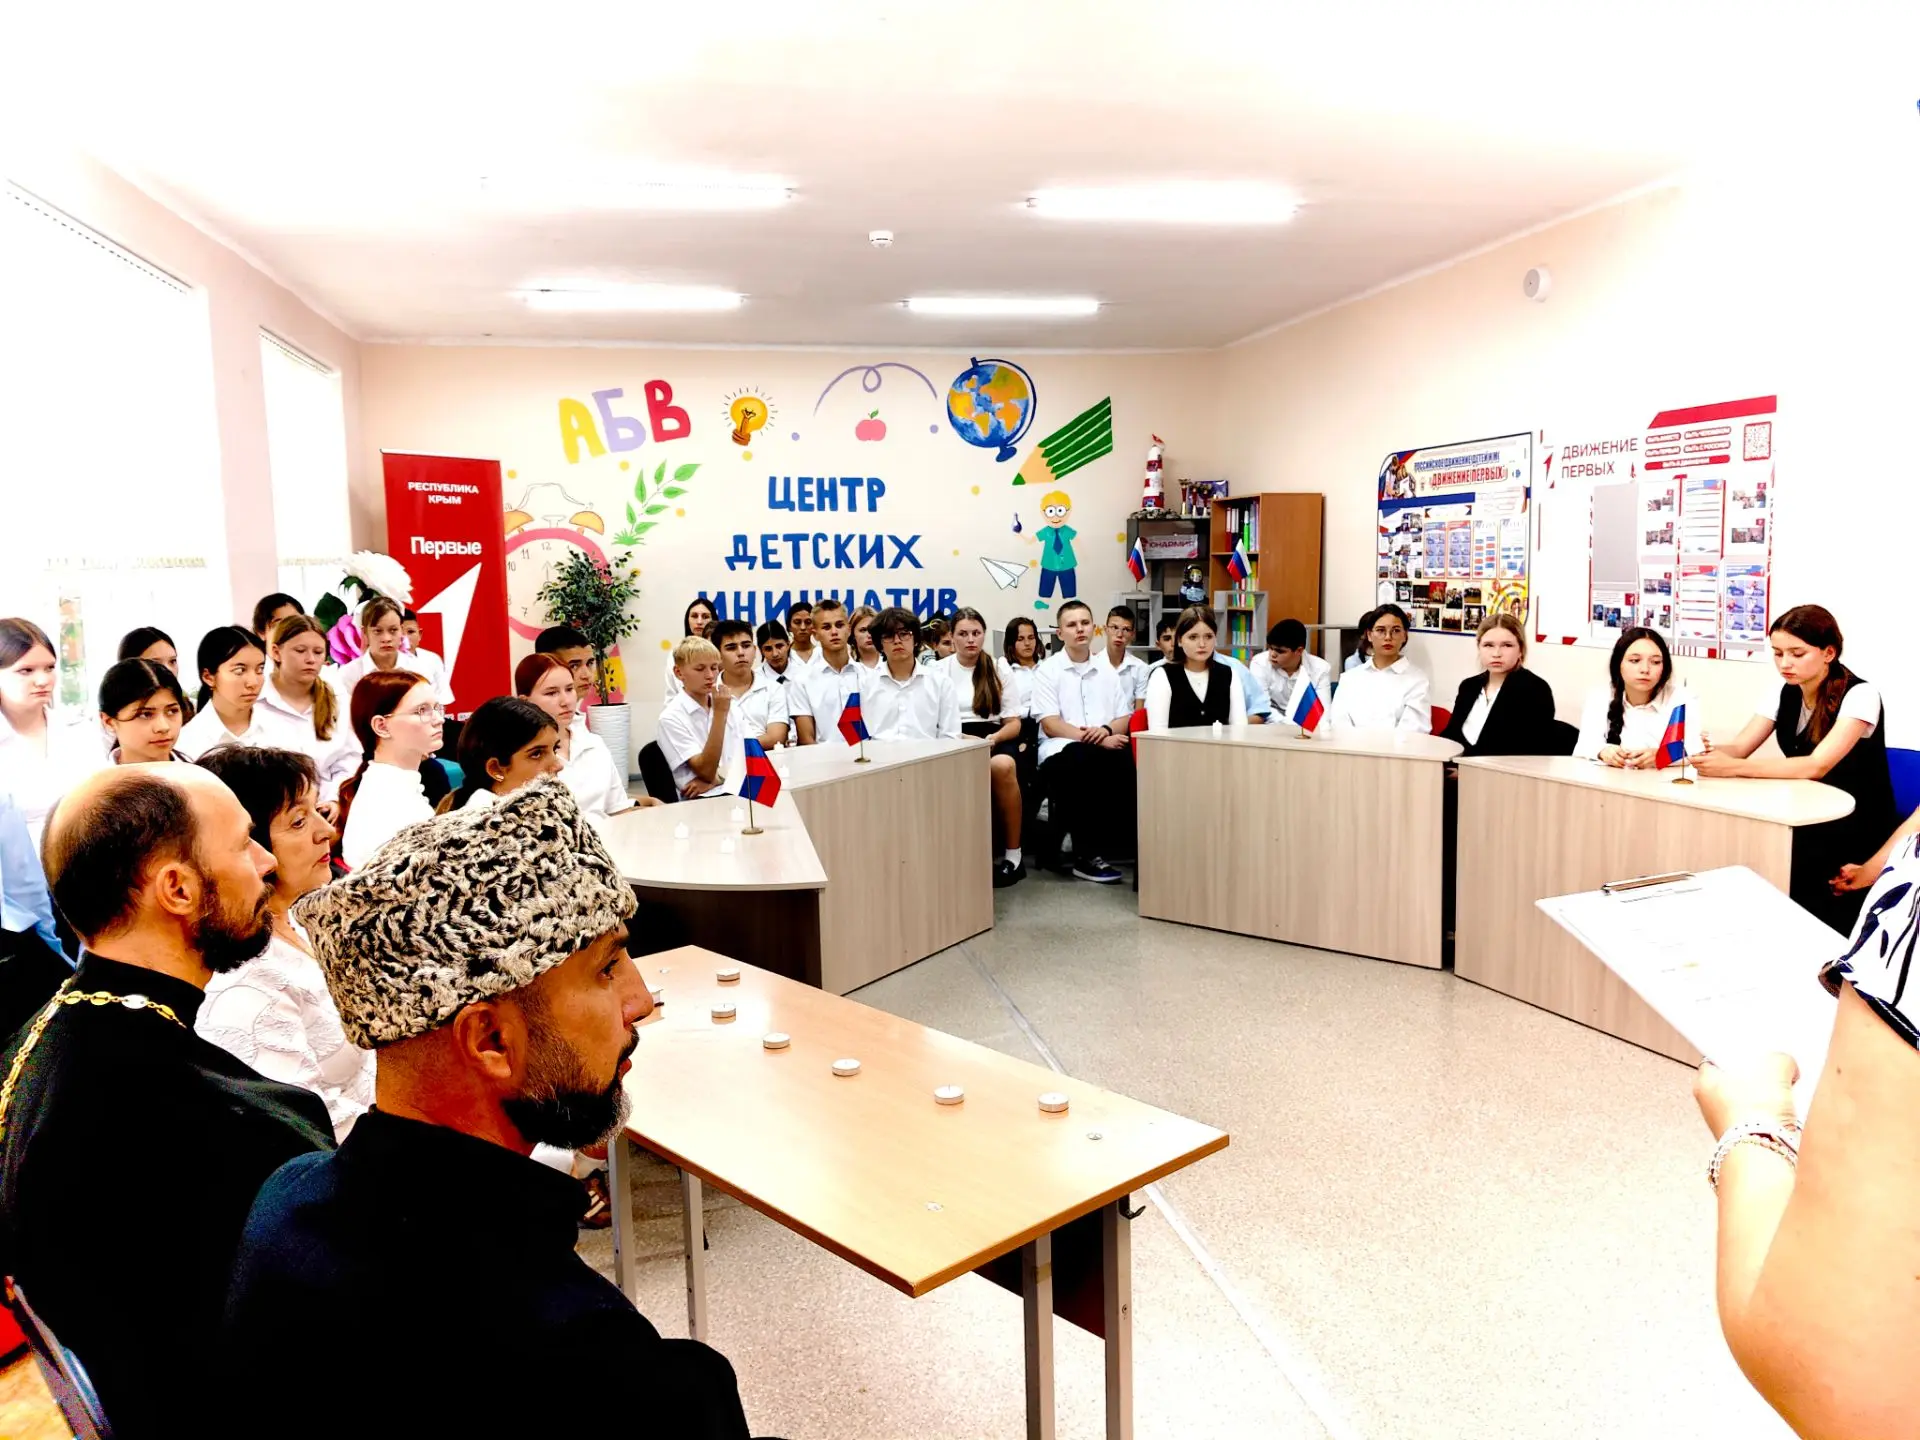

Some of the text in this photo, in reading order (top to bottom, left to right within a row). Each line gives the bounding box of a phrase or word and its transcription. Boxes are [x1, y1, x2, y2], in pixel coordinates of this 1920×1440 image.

[558, 379, 692, 465] АБВ
[1562, 438, 1638, 461] ДВИЖЕНИЕ
[1562, 461, 1615, 479] ПЕРВЫХ
[408, 481, 480, 494] РЕСПУБЛИКА
[428, 494, 462, 505] КРЫМ
[768, 475, 886, 512] ЦЕНТР
[410, 536, 482, 560] Первые
[725, 532, 924, 571] ДЕТСКИХ
[698, 588, 958, 627] ИНИИАТИВ
